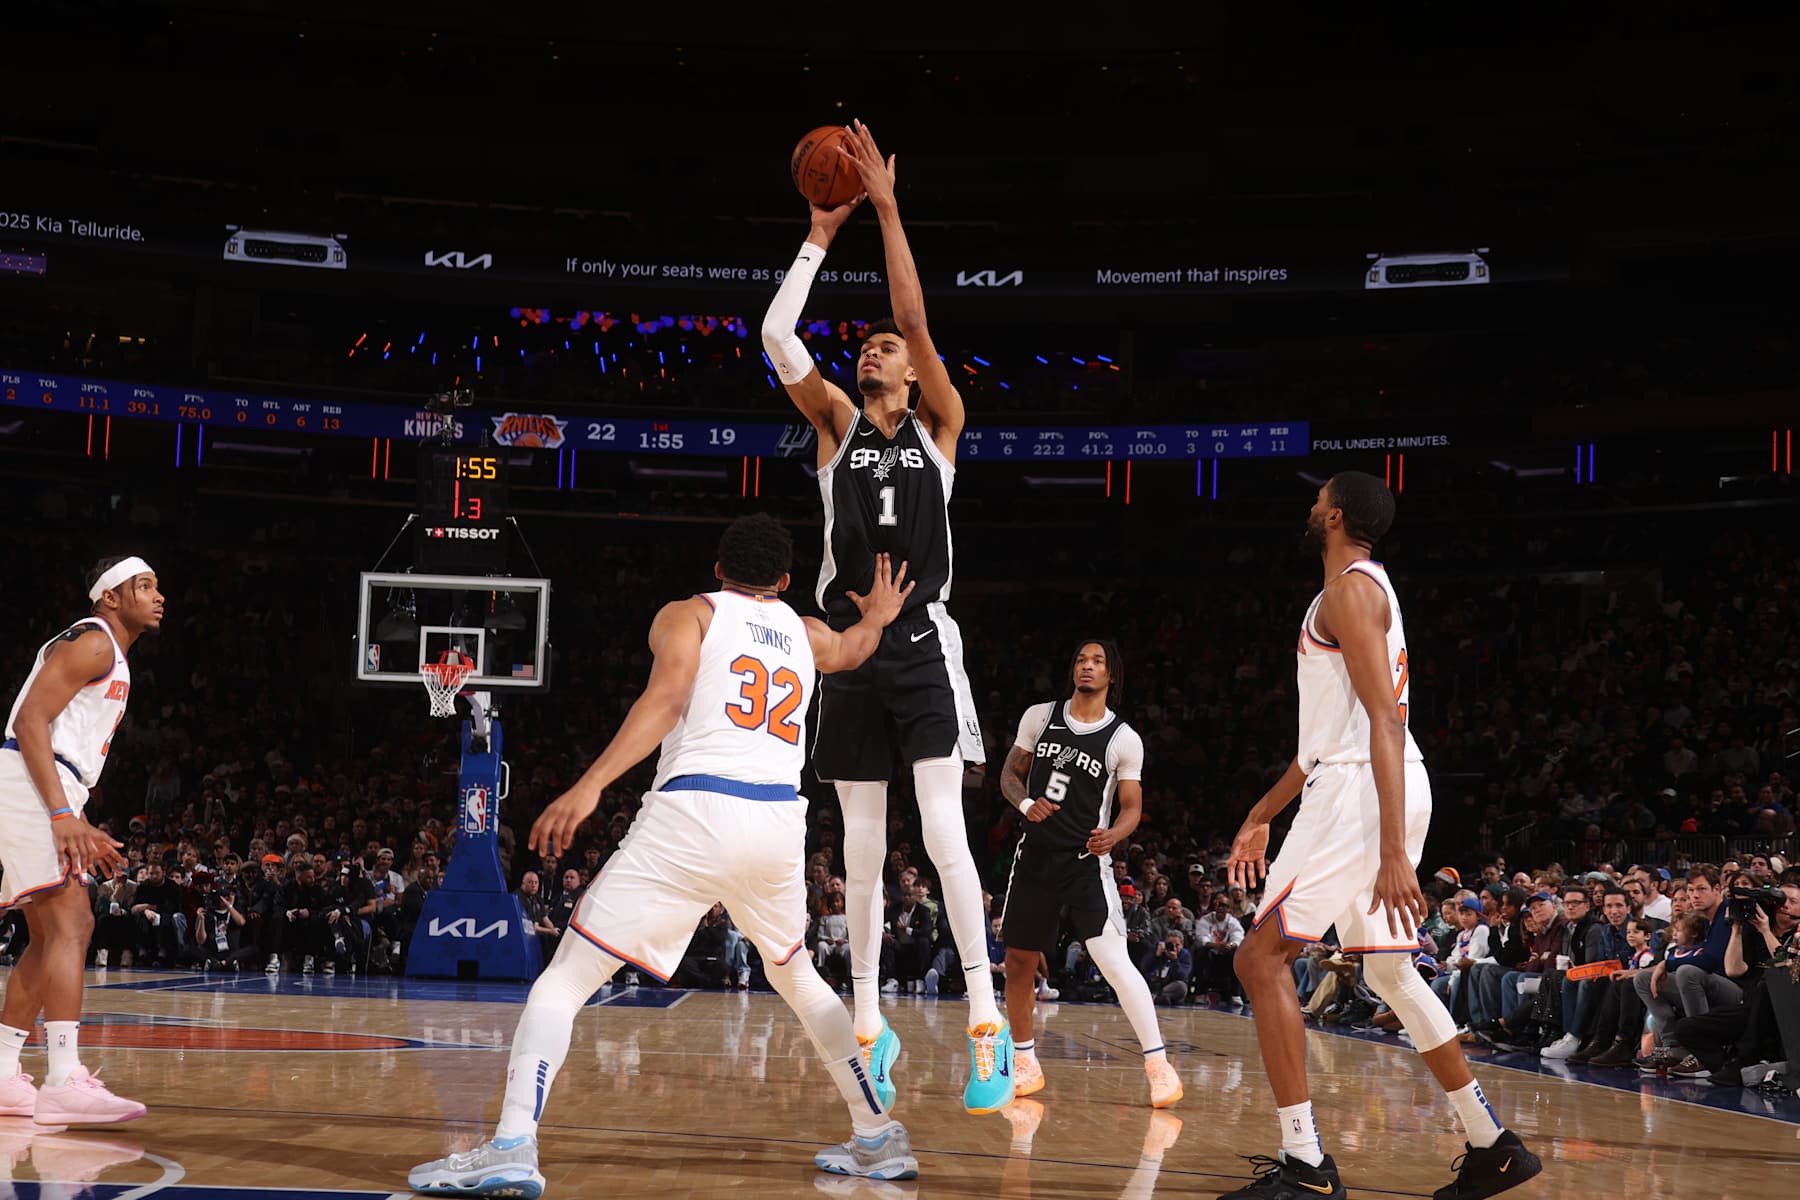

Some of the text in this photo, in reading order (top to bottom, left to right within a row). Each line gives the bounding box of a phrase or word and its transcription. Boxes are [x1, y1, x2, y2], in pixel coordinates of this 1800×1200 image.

[0, 211, 145, 242] 025 Kia Telluride.
[424, 250, 493, 270] KIA
[566, 257, 578, 273] If
[581, 259, 617, 278] only
[621, 263, 658, 278] your
[661, 263, 704, 279] seats
[708, 267, 748, 280] were
[751, 268, 770, 281] as
[819, 268, 838, 282] as
[842, 270, 882, 284] ours.
[956, 270, 1024, 287] KIA
[1096, 266, 1288, 285] Movement that inspires
[38, 378, 58, 389] TOL
[235, 398, 249, 407] TO
[262, 400, 281, 410] STL
[292, 403, 311, 412] AST
[6, 388, 341, 430] 2 6 11.1 39.1 75.0 0 0 6 13
[404, 419, 464, 439] KNICS
[497, 415, 562, 441] KNICKS
[587, 423, 616, 441] 22
[709, 428, 736, 445] 19
[999, 431, 1018, 440] TOL
[1185, 430, 1199, 438] TO
[1240, 428, 1259, 437] AST
[639, 432, 684, 450] 1:55
[969, 440, 1285, 456] 3 6 22.2 41.2 100.0 3 0 4 11
[1312, 434, 1450, 451] FOUL UNDER 2 MINUTES.
[456, 456, 497, 480] 1:55
[453, 479, 481, 519] 1.3
[878, 485, 898, 527] 1
[445, 527, 500, 540] TISSOT
[745, 620, 793, 657] TOWNS
[725, 653, 803, 746] 32
[1036, 741, 1103, 779] SPURS
[1044, 769, 1072, 803] 5
[428, 917, 509, 939] KIA
